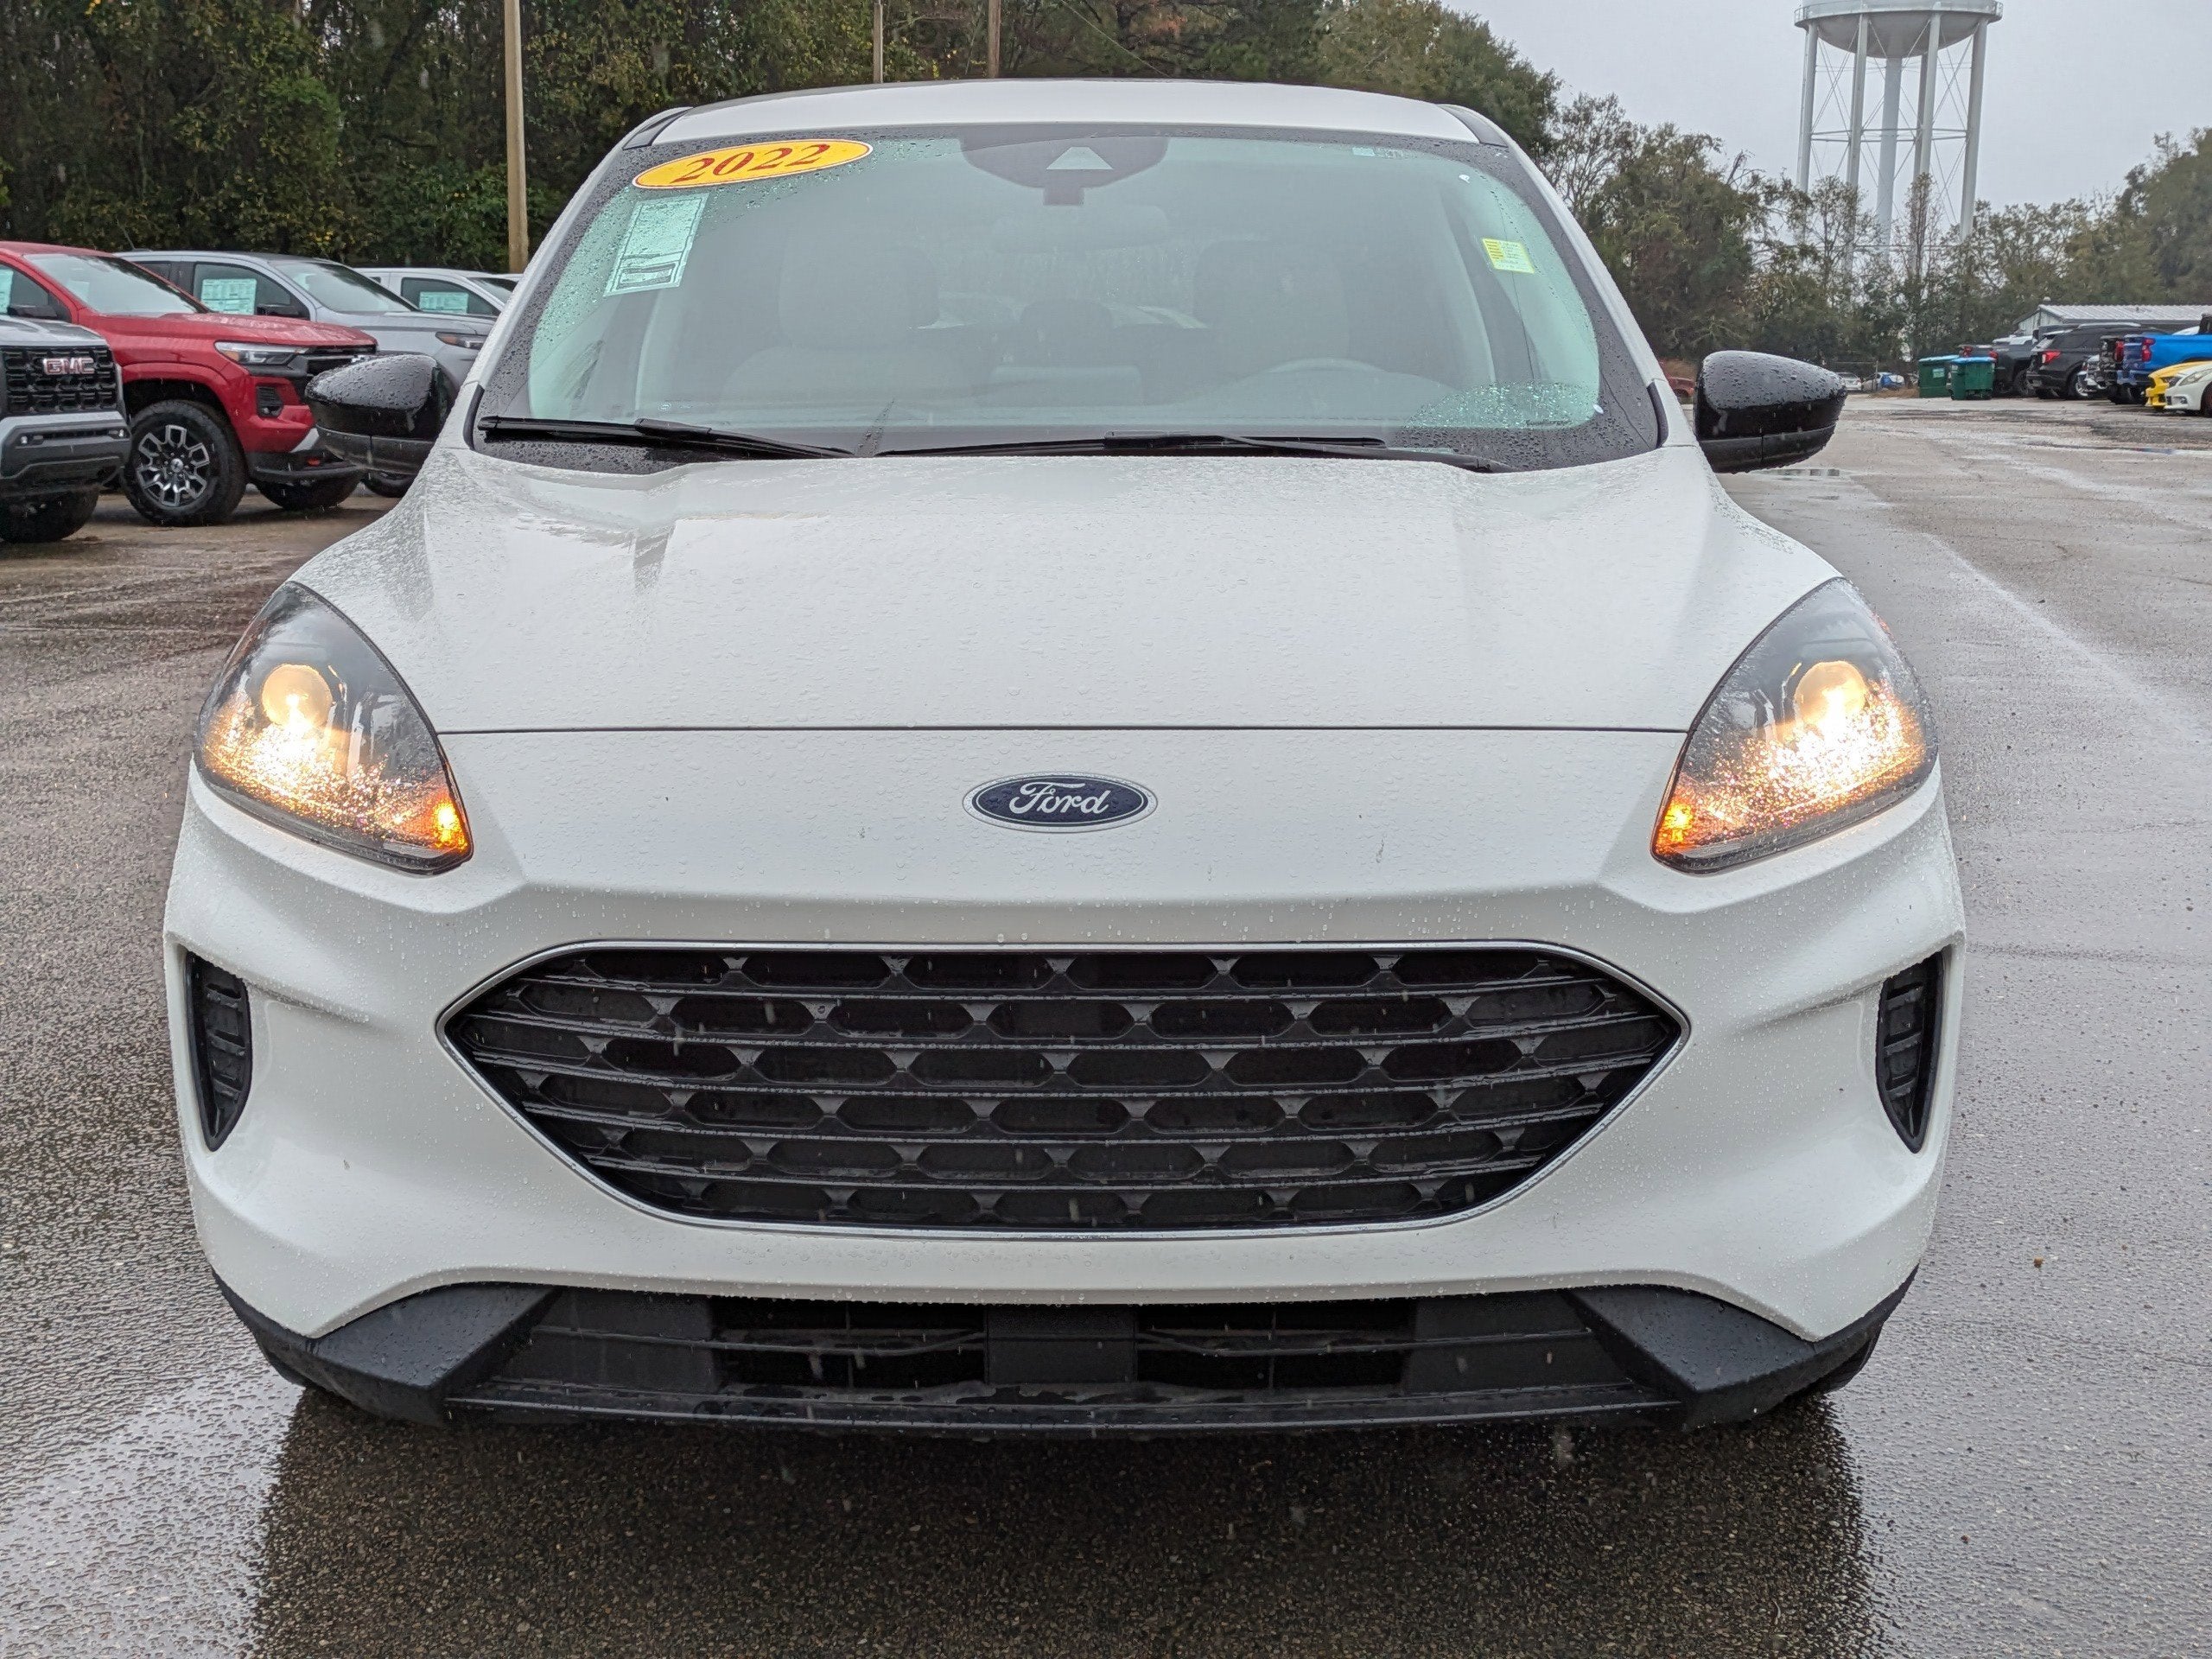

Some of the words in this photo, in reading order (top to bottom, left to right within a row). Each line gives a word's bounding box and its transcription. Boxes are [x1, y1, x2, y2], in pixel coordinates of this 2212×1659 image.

[670, 143, 830, 183] 2022
[43, 357, 95, 375] GMC
[1008, 781, 1112, 815] Ford
